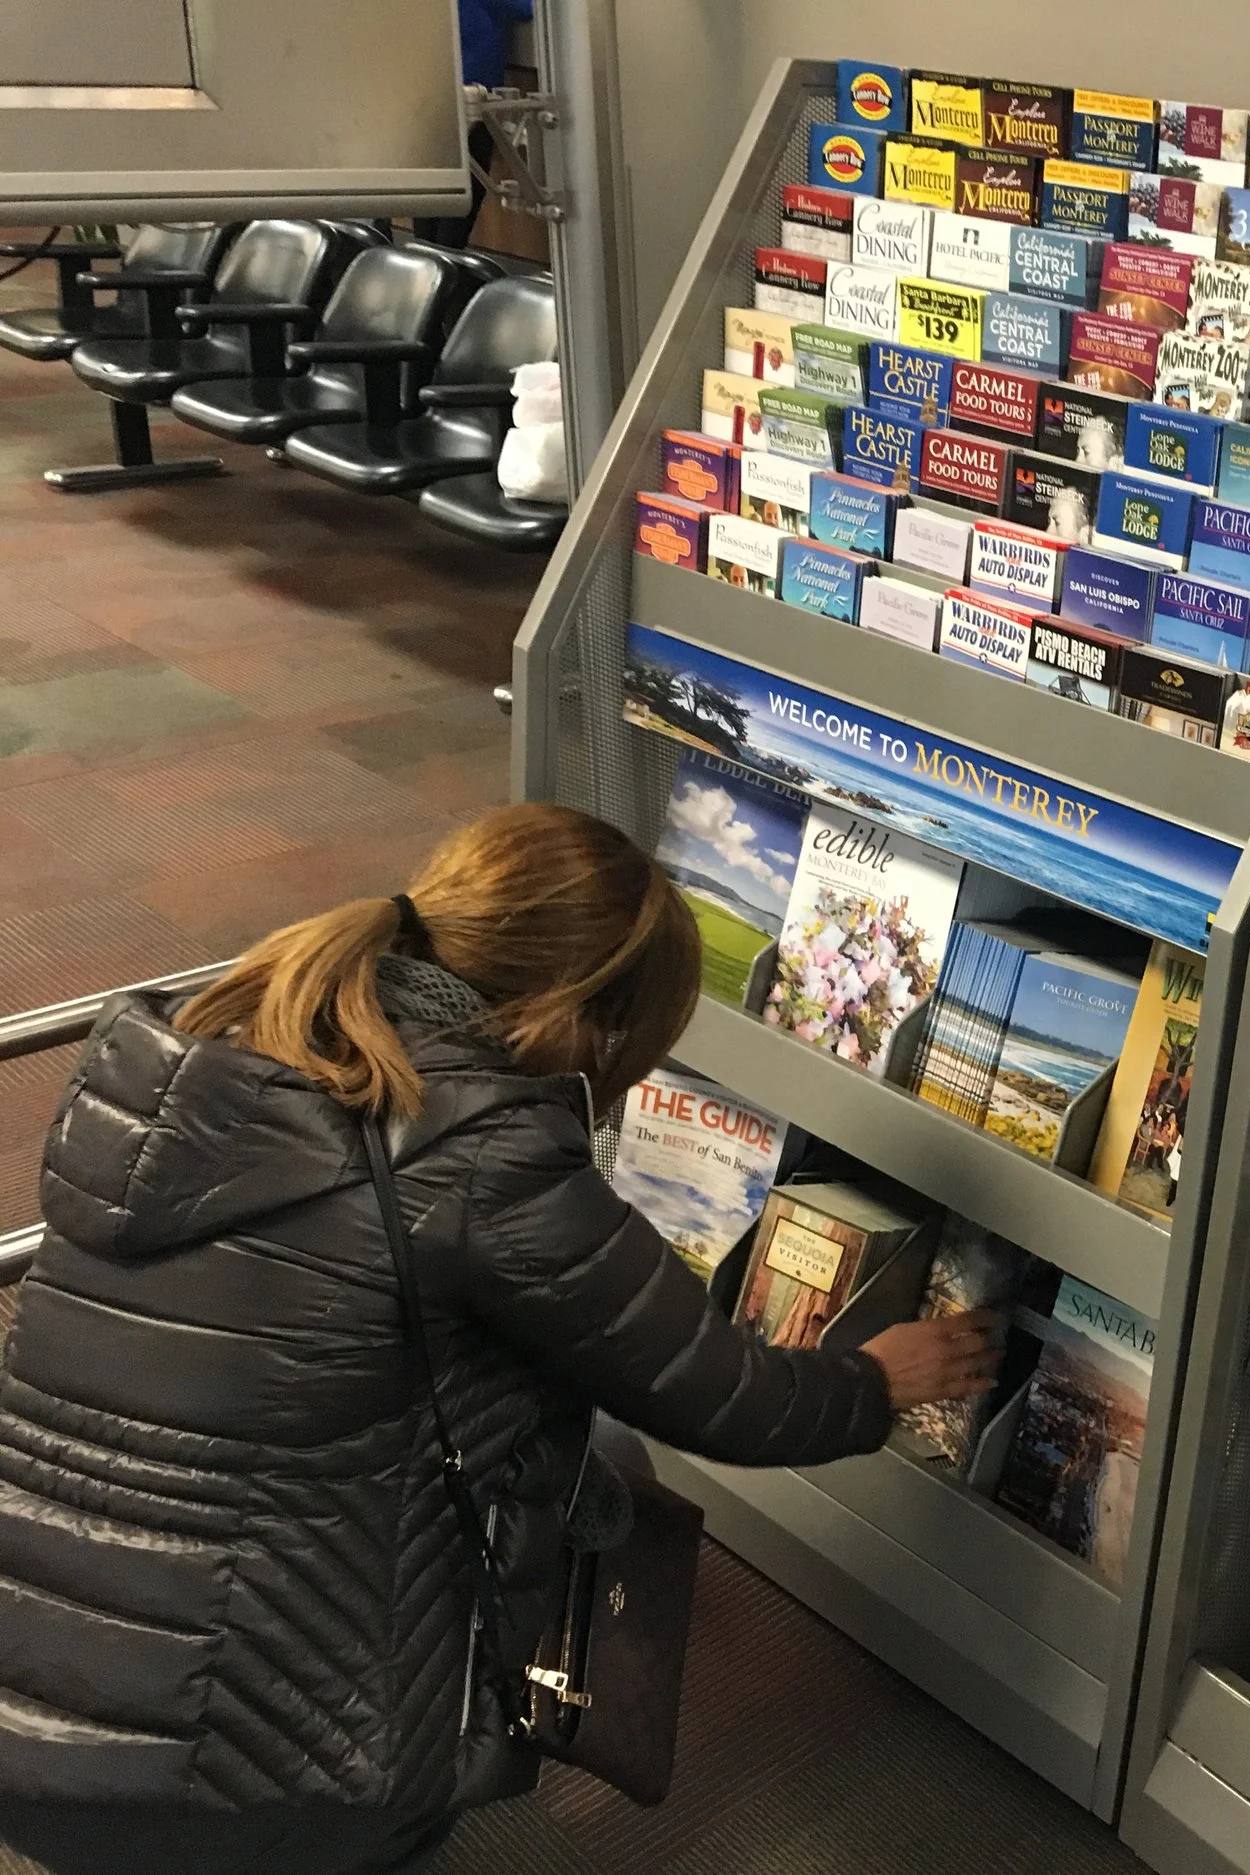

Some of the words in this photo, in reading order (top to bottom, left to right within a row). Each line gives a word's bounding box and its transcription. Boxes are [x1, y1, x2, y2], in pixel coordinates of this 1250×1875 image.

[916, 100, 979, 135] Monterey
[1084, 116, 1138, 138] PASSPORT
[1083, 134, 1139, 155] MONTEREY
[889, 160, 952, 195] Monterey
[856, 237, 917, 265] DINING
[1023, 269, 1069, 291] COAST
[828, 296, 890, 329] DINING
[990, 319, 1052, 345] CENTRAL
[998, 338, 1044, 359] COAST
[878, 347, 944, 381] HEARST
[956, 370, 1026, 403] CARMEL
[851, 411, 915, 448] HEARST
[928, 439, 998, 473] CARMEL
[1149, 451, 1185, 471] LODGE
[716, 523, 773, 559] Passionfish
[1122, 520, 1158, 540] LODGE
[978, 534, 1051, 569] WARBIRDS
[978, 556, 1006, 578] AUTO
[1007, 563, 1049, 589] DISPLAY
[1069, 580, 1089, 593] SAN
[1089, 586, 1108, 600] LUIS
[1108, 591, 1140, 610] OBISPO
[951, 601, 1027, 645] WARBIRDS
[949, 623, 979, 646] AUTO
[979, 632, 1023, 664] DISPLAY
[1035, 626, 1070, 652] PISMO
[1072, 639, 1106, 664] BEACH
[769, 691, 872, 751] WELCOME
[879, 734, 908, 763] TO
[912, 740, 1099, 838] MONTEREY
[813, 820, 895, 874] edible
[1042, 981, 1086, 1003] PACIFIC
[1088, 994, 1127, 1015] GROVE
[637, 1080, 696, 1122] THE
[699, 1100, 777, 1155] GUIDE
[634, 1126, 659, 1144] The
[662, 1133, 697, 1153] BEST
[697, 1144, 711, 1157] of
[712, 1148, 732, 1166] San
[733, 1158, 764, 1182] Benito
[777, 1233, 836, 1269] SEQUOIA
[778, 1247, 828, 1277] VISITOR
